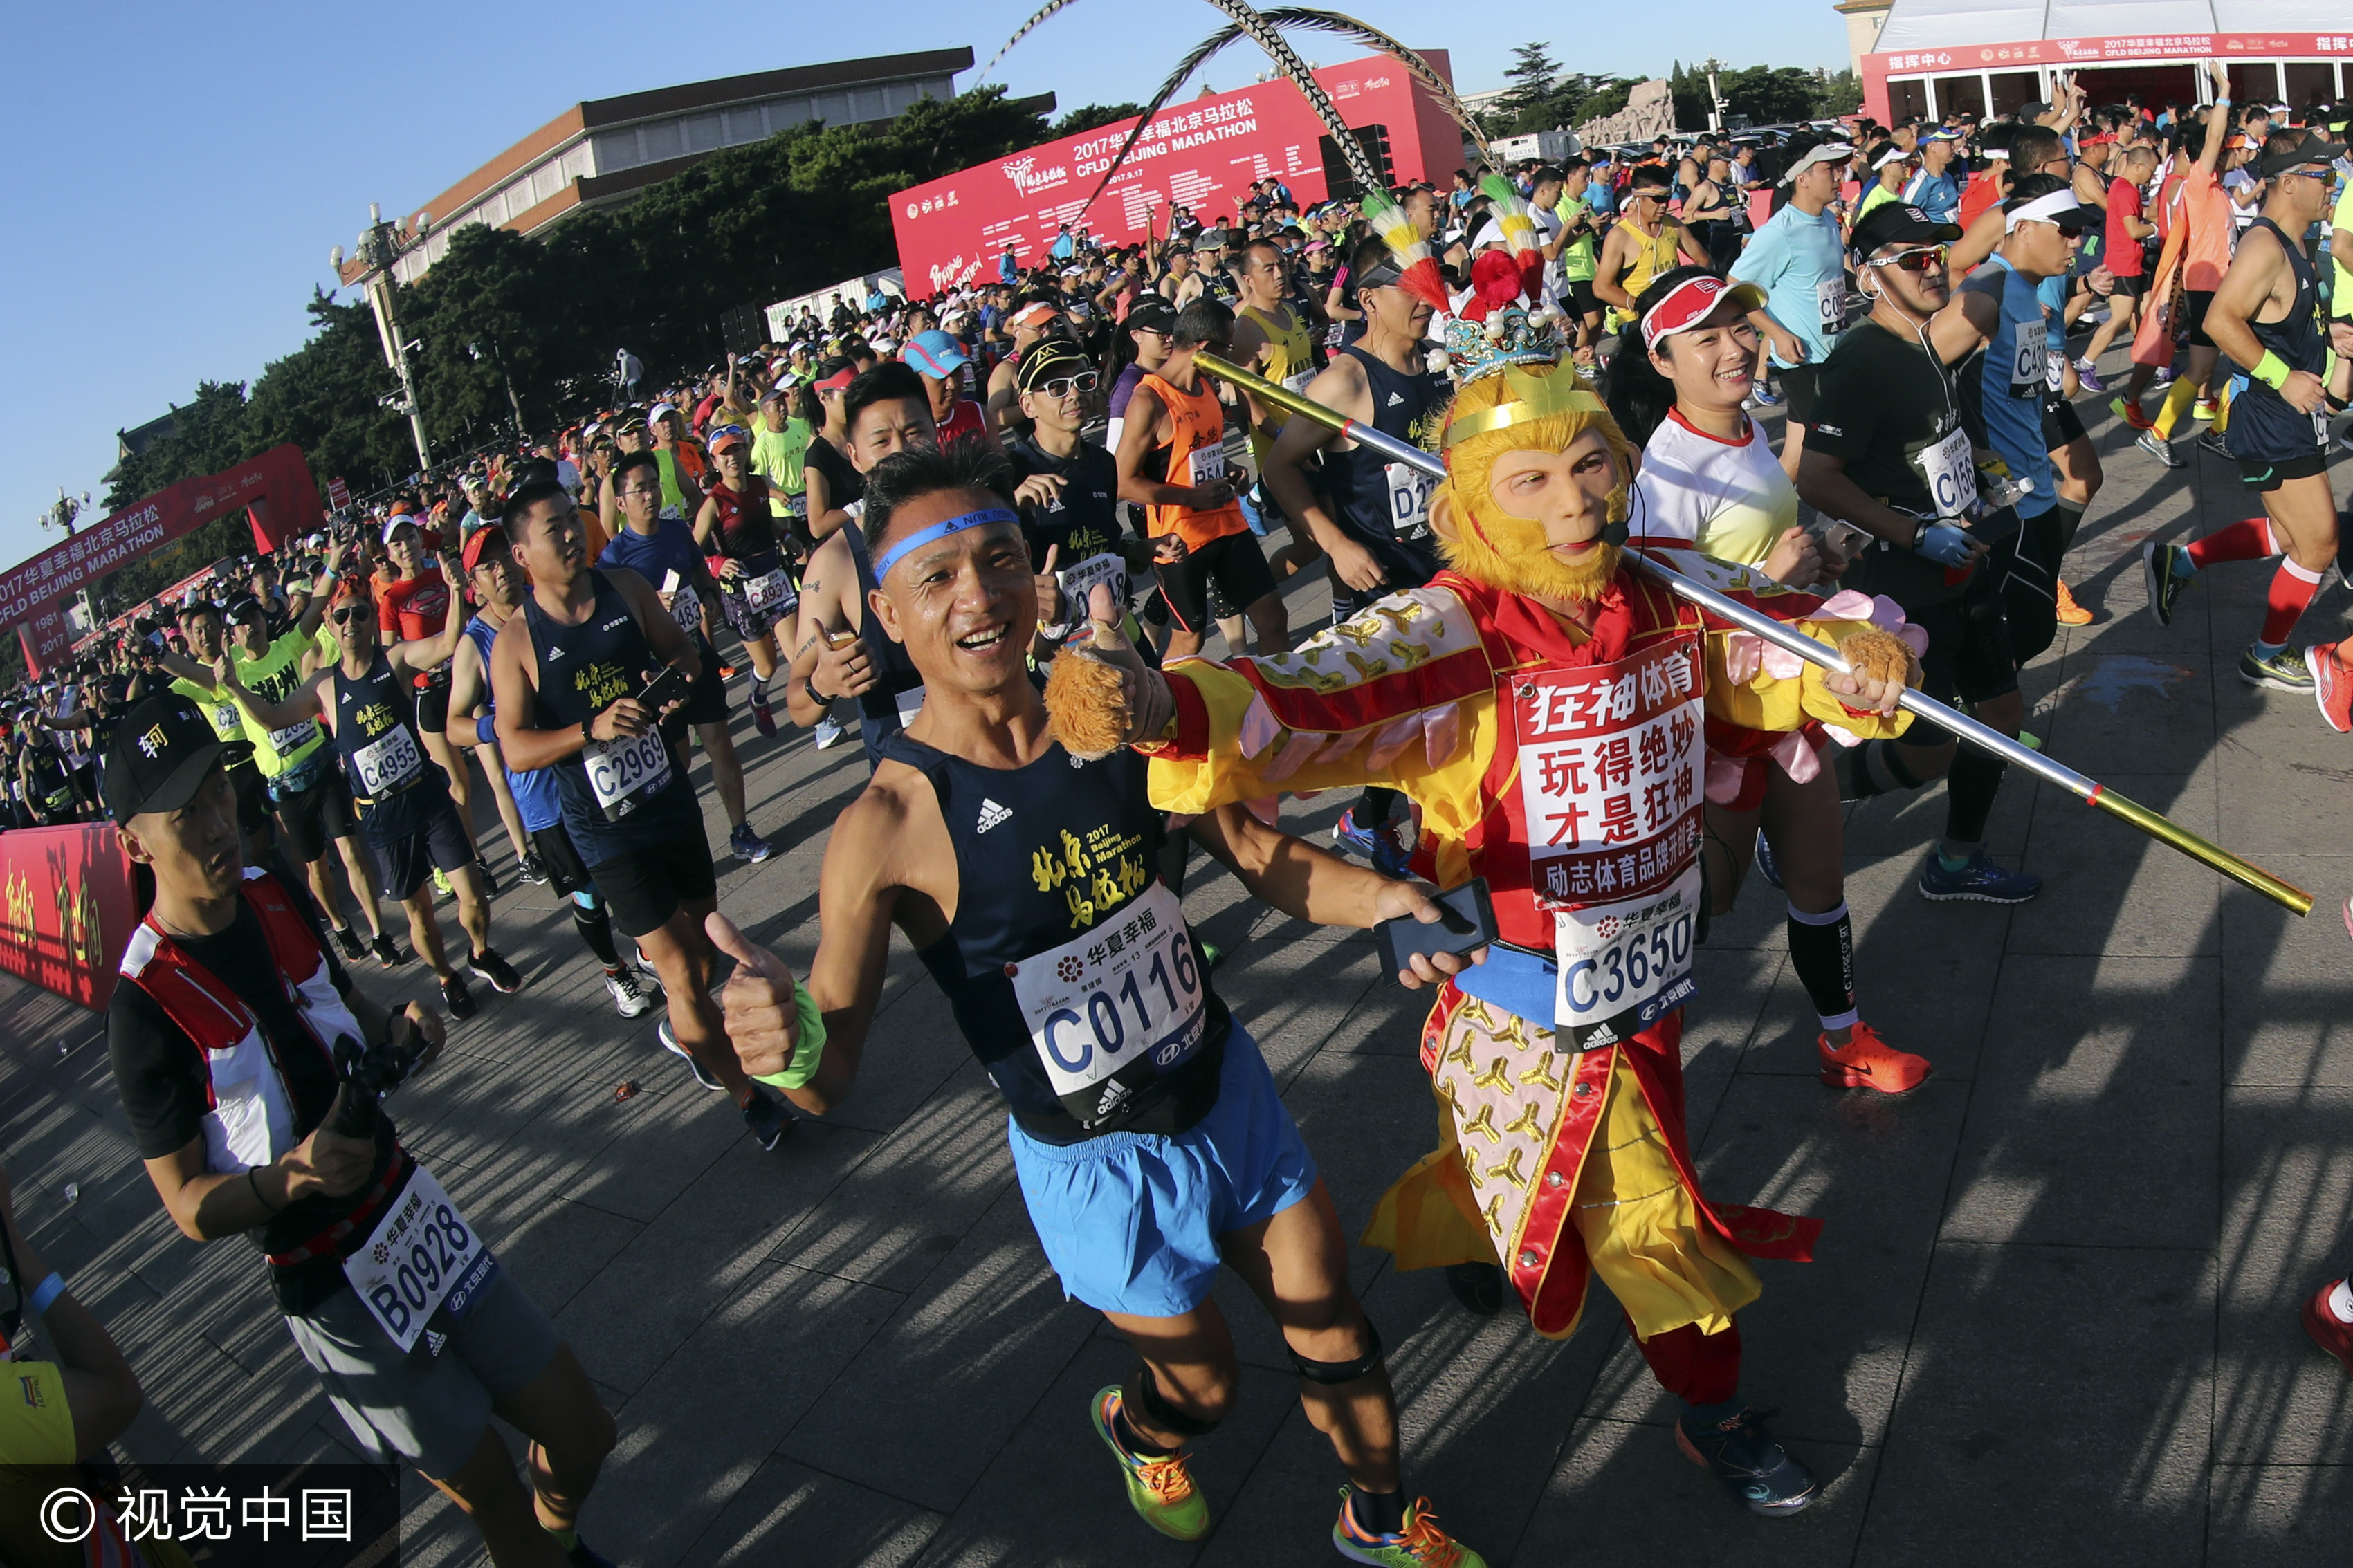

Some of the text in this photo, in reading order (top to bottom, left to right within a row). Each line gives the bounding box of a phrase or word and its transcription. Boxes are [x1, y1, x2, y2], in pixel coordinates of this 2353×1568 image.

[1889, 52, 1951, 70] 指挥中心
[2127, 48, 2161, 56] BEIJING
[2163, 46, 2213, 55] MARATHON
[2316, 37, 2353, 51] 指挥
[1076, 158, 1110, 178] CFLD
[1172, 119, 1257, 151] MARATHON
[30, 566, 83, 606] BEIJING
[87, 524, 164, 574] MARATHON
[751, 578, 790, 609] C8931
[35, 611, 59, 632] 1981
[40, 633, 65, 656] 2017
[1528, 649, 1694, 736] 狂神体育
[364, 739, 417, 787] C4955
[595, 731, 664, 796] C2969
[1537, 709, 1696, 797] 玩得绝妙
[976, 807, 1014, 835] adidas
[1545, 762, 1693, 850] 才是狂神
[1086, 823, 1110, 844] 2017
[1090, 833, 1121, 853] Beijing
[1095, 833, 1142, 865] Marathon
[1032, 829, 1091, 892] 北京
[1546, 815, 1697, 898] 励志体育品牌开创者
[1065, 854, 1146, 928] 马拉松
[1623, 889, 1682, 928] 华夏幸福
[1086, 907, 1157, 967] 华夏幸福
[1130, 950, 1142, 963] 13
[1564, 912, 1692, 1013] C3650
[1043, 931, 1197, 1073] C0116
[1659, 978, 1695, 1010] 北京现代
[1583, 1034, 1619, 1051] adidas
[1097, 1087, 1133, 1115] adidas
[387, 1190, 423, 1246] 华夏幸福
[369, 1203, 470, 1338] B0928
[464, 1255, 493, 1295] 北京现代
[432, 1332, 448, 1356] adidas
